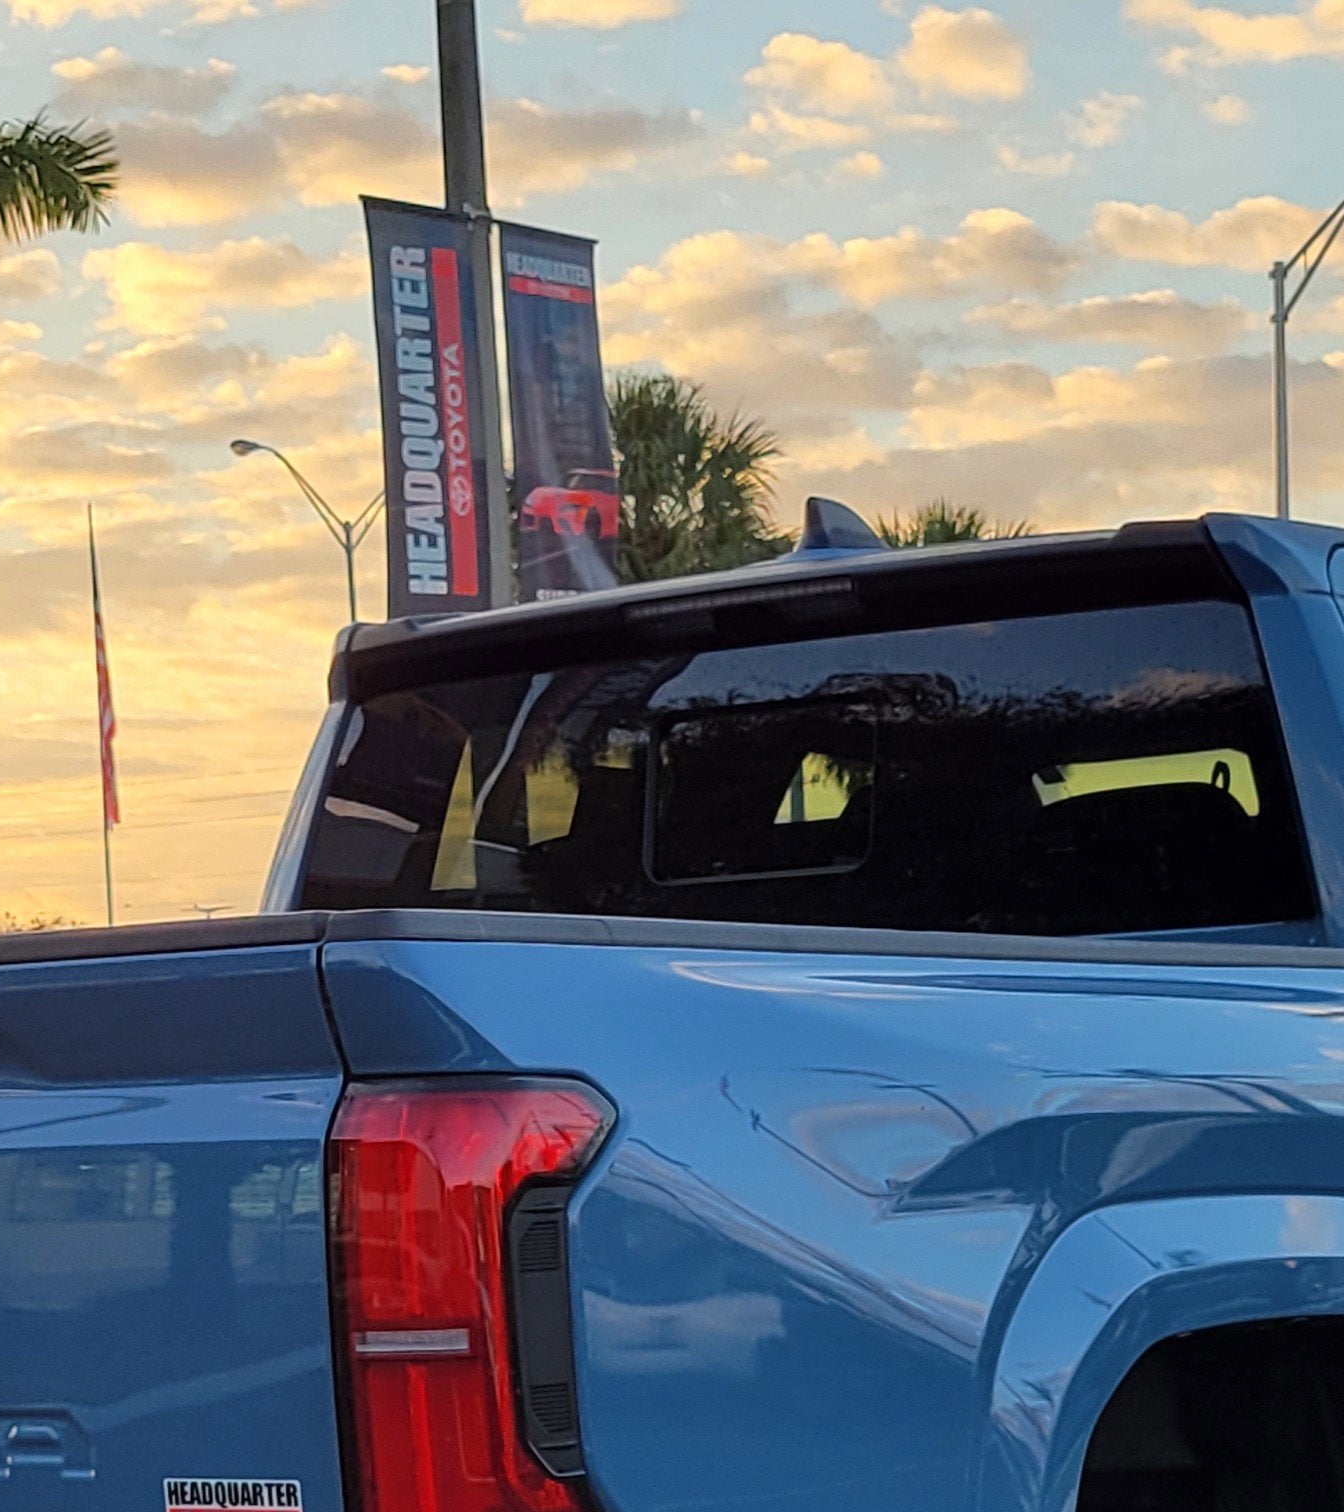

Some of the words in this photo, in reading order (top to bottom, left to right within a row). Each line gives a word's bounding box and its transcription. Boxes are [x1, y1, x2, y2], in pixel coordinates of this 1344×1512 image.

[390, 245, 449, 595] HEADQUARTER
[443, 343, 468, 470] TOYOTA
[167, 1480, 300, 1508] HEADQUARTER
